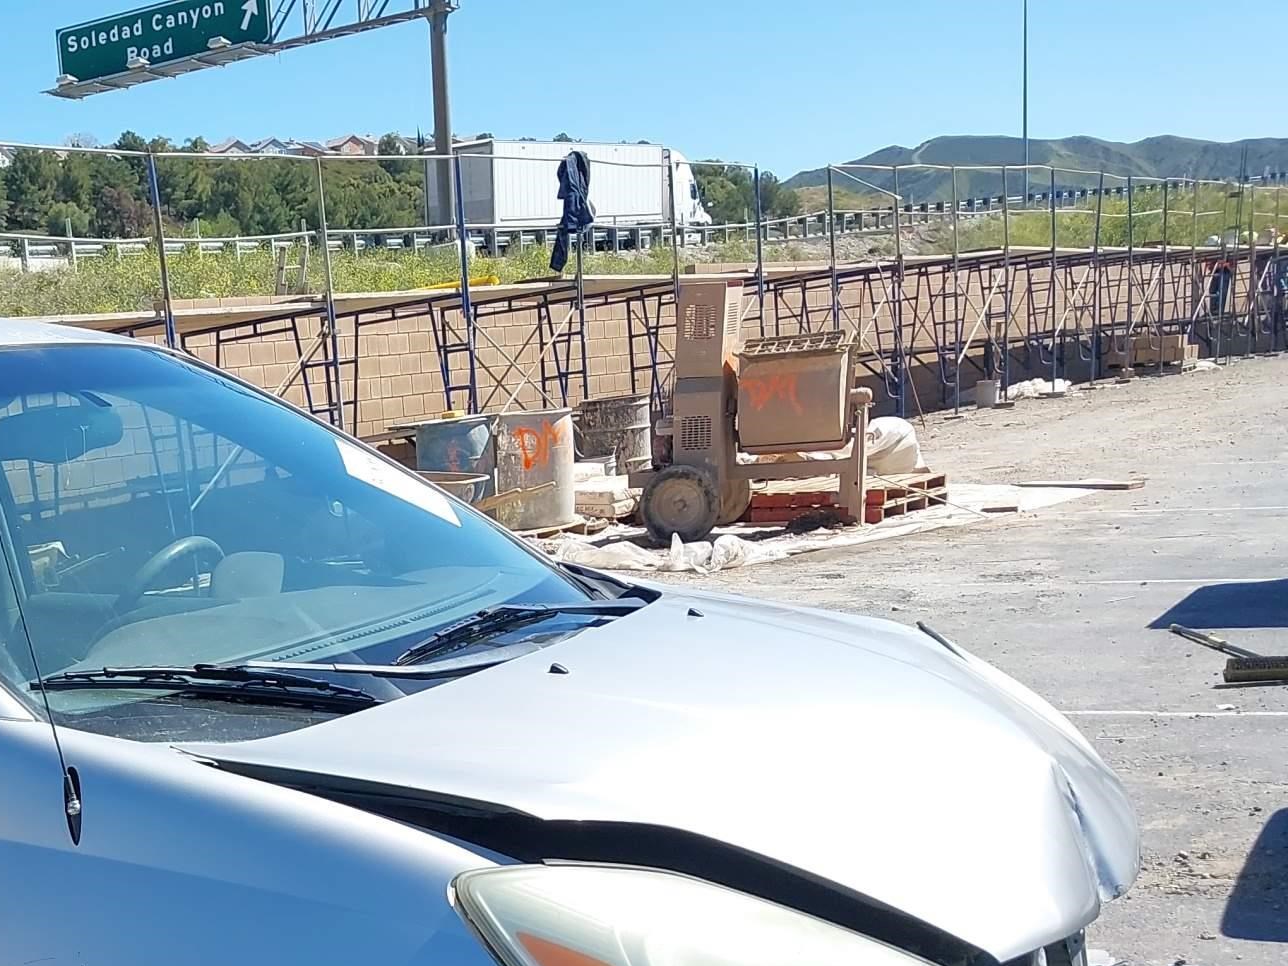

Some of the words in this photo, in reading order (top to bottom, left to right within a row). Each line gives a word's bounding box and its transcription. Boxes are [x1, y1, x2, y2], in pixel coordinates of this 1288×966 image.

[67, 18, 143, 52] Soledad
[152, 2, 224, 31] Canyon
[127, 37, 173, 61] Road
